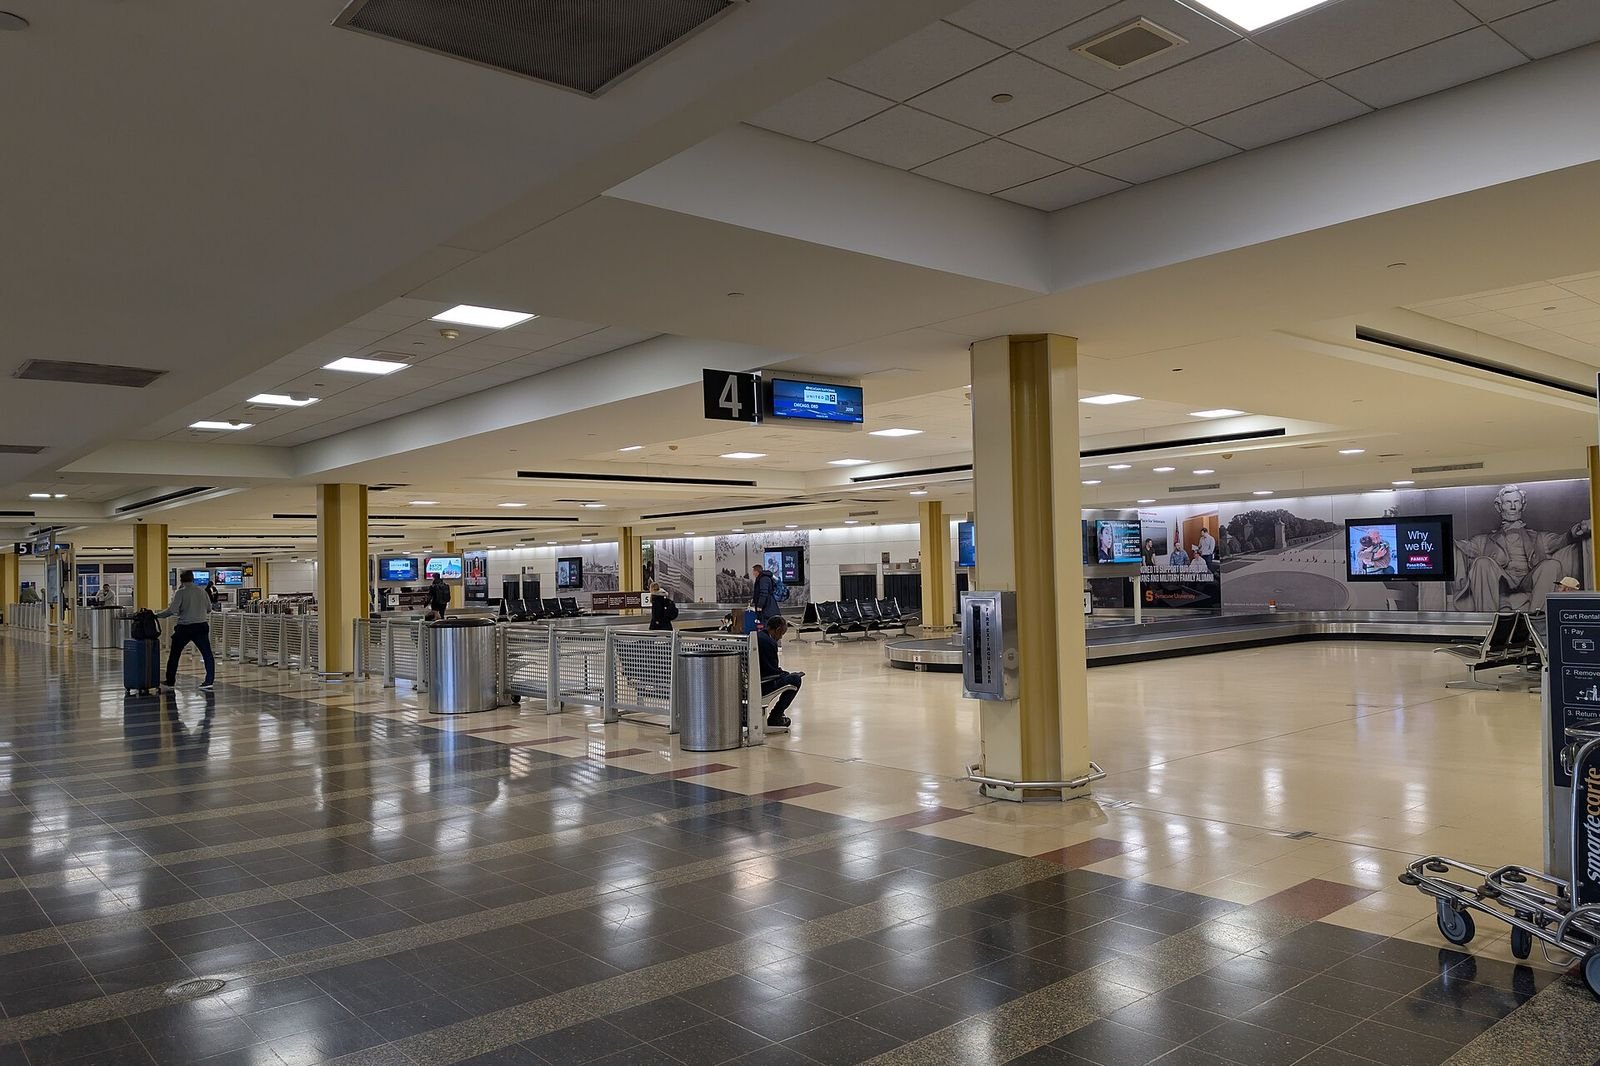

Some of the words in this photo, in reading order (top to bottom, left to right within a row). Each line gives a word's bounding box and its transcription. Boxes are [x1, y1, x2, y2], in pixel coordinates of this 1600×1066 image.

[719, 374, 742, 418] 4
[1407, 531, 1428, 541] Why
[19, 543, 28, 554] 5
[1421, 541, 1434, 552] fly.
[1159, 565, 1179, 573] SUPPORT
[1571, 628, 1584, 636] Pay
[1575, 710, 1597, 718] Return
